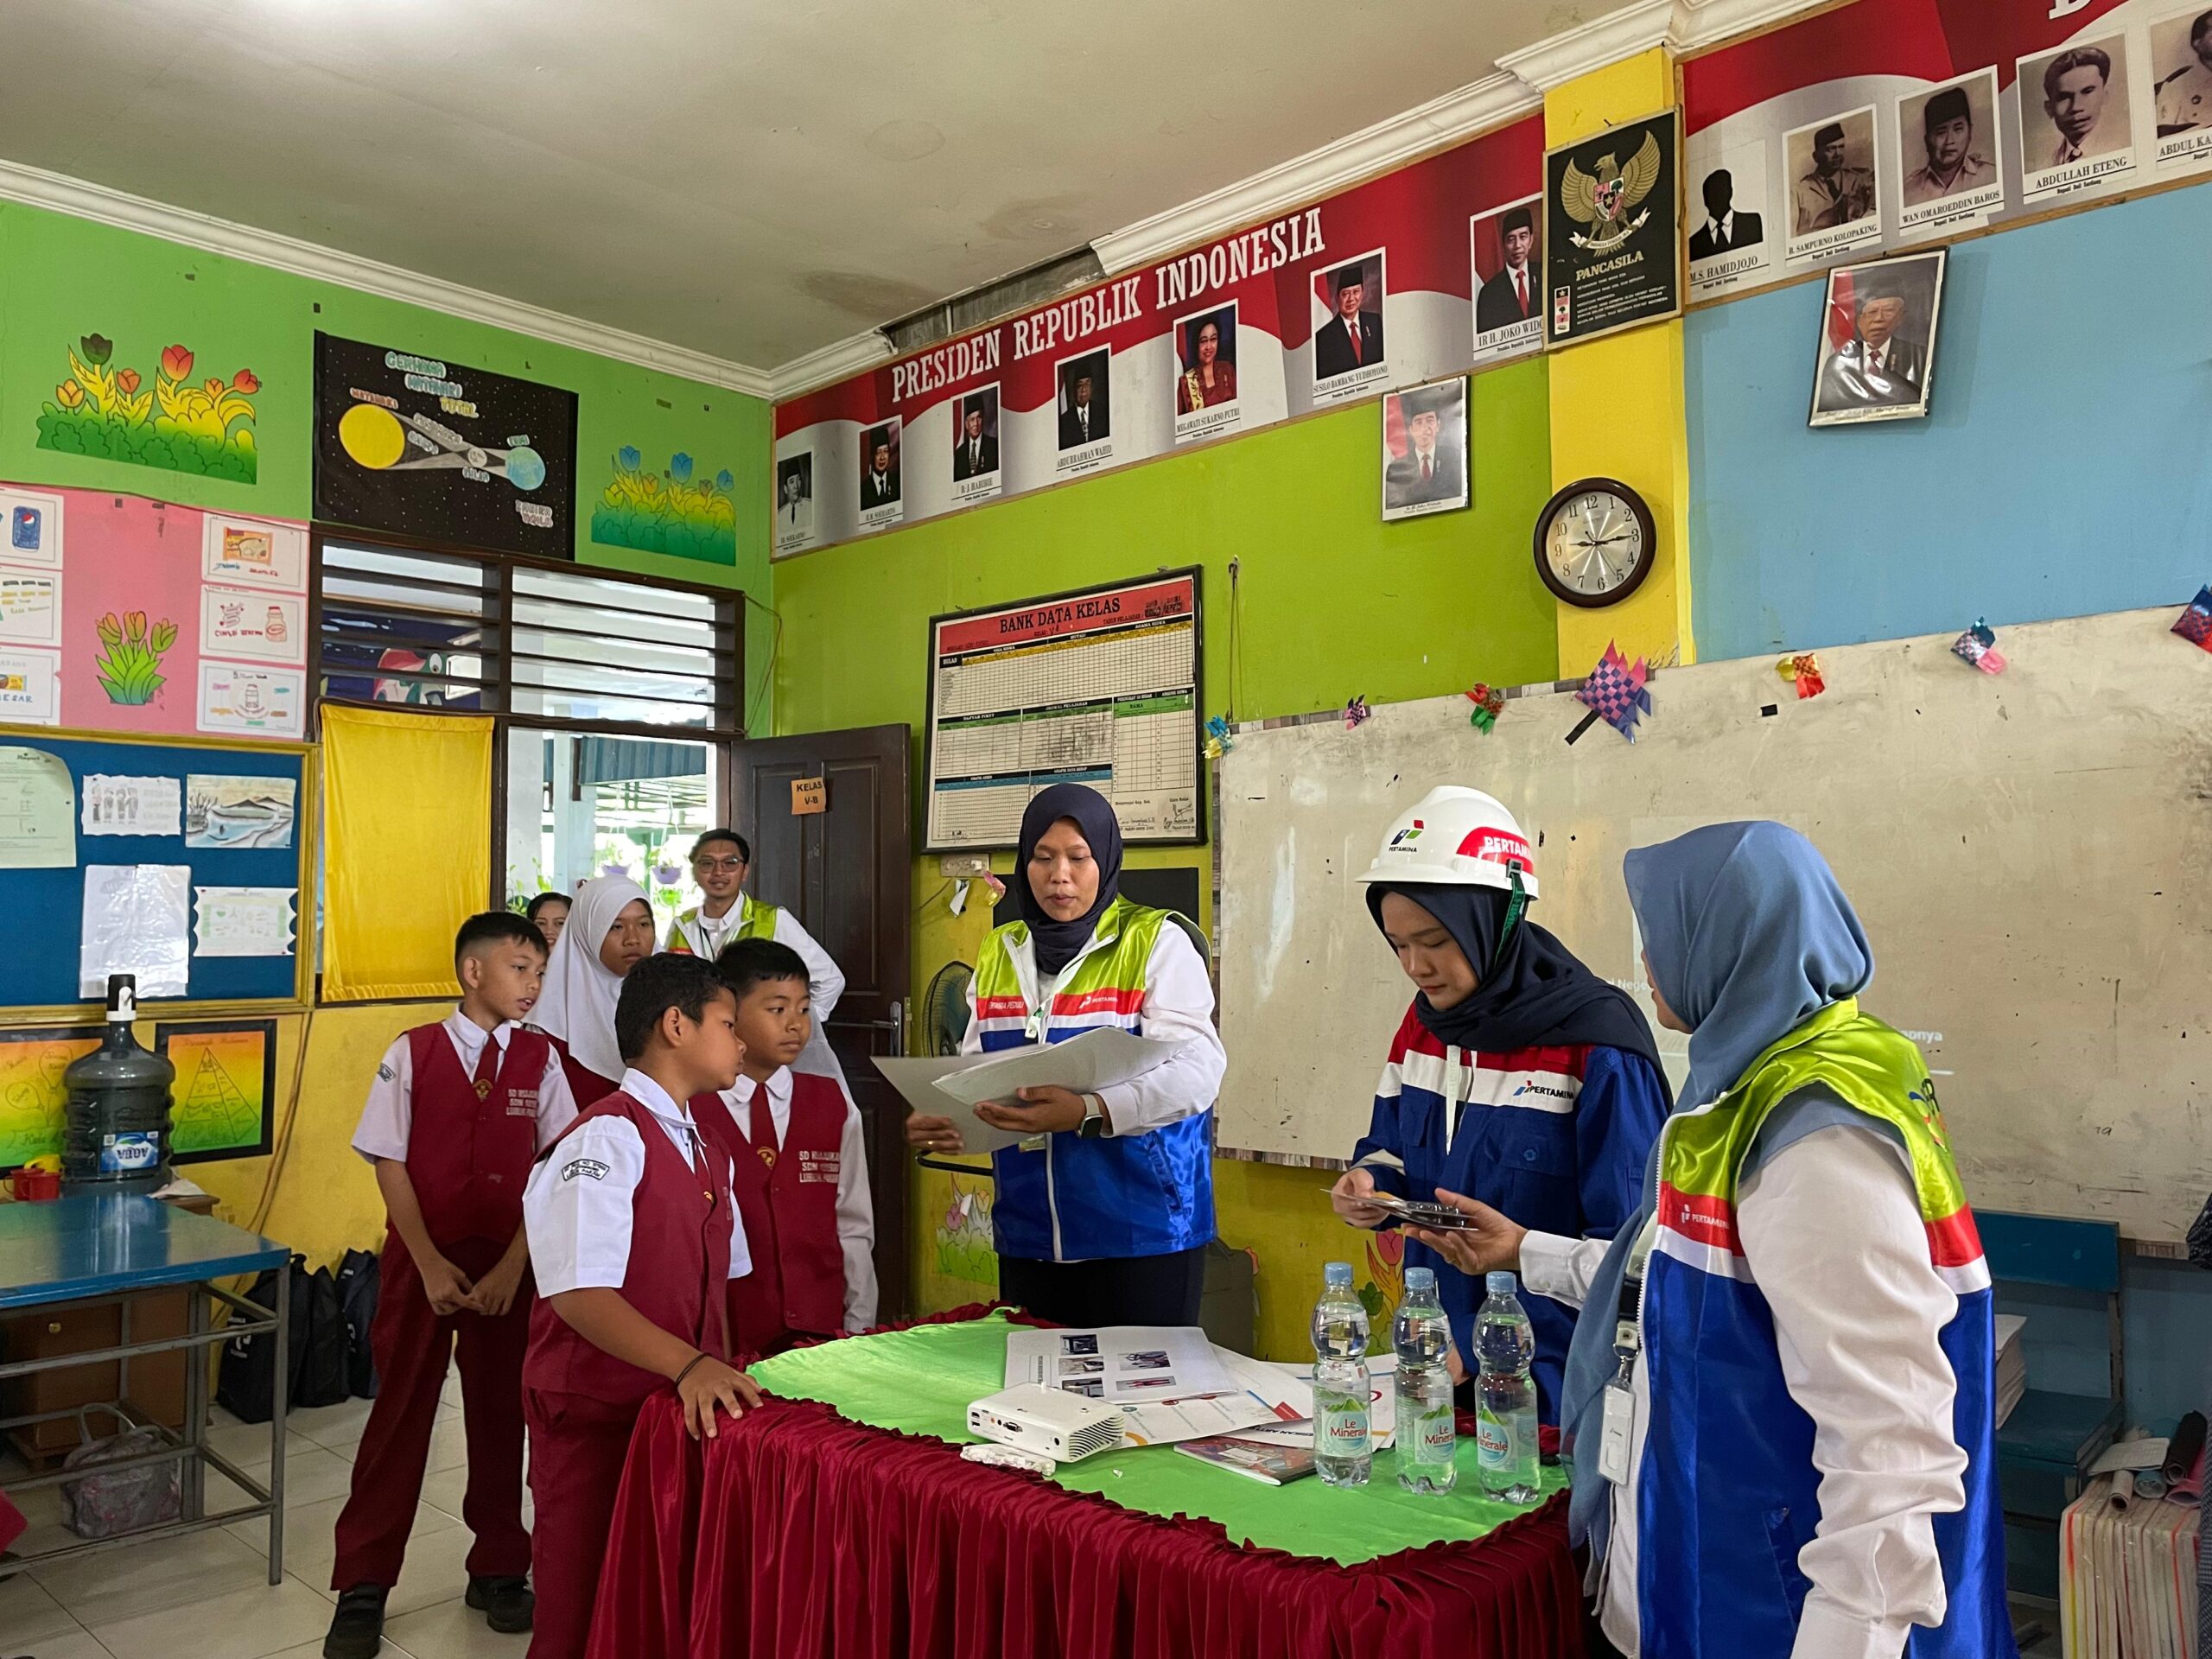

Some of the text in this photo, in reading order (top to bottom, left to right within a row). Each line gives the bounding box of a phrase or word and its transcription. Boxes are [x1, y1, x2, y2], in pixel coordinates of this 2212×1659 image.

[2159, 140, 2195, 158] ABDUL
[2036, 156, 2127, 189] ABDULLAH ETENG
[1903, 190, 2000, 225] WAN OMAROEDDIN BAROS
[1796, 236, 1833, 253] SAMPURNO
[1834, 224, 1878, 244] KOLOPAKING
[1575, 251, 1644, 281] PANCASILA
[1707, 256, 1758, 278] HAMIDJOJO
[891, 207, 1325, 403] PRESIDEN REPUBLIK INDONESIA
[1490, 332, 1498, 345] H.
[1499, 327, 1521, 341] JOKO
[1313, 365, 1387, 393] SUSILO BAMBANG YUDHOYONO
[1177, 408, 1240, 433] MEGAWATI SUKARNO PUTRI
[1057, 450, 1094, 468] ABDURRAHMAN
[1095, 444, 1112, 457] WAHID
[1586, 495, 1598, 510] 12
[1610, 496, 1614, 509] 1
[1568, 504, 1579, 518] 11
[1624, 508, 1632, 522] 2
[1556, 522, 1567, 537] 10
[1631, 529, 1639, 542] 3
[1555, 543, 1562, 556] 9
[1627, 551, 1635, 564] 4
[1563, 563, 1571, 576] 8
[1616, 569, 1624, 582] 5
[1578, 575, 1585, 588] 7
[1598, 577, 1605, 590] 6
[1000, 613, 1034, 633] BANK
[1038, 606, 1072, 627] DATA
[1077, 598, 1121, 620] KELAS
[797, 781, 823, 792] KELAS
[804, 796, 818, 804] V-B
[1484, 836, 1532, 858] PERTAM
[117, 1147, 149, 1160] AQUA
[799, 1150, 809, 1160] SD
[1344, 1418, 1356, 1429] Le
[1439, 1425, 1448, 1435] Le
[1482, 1428, 1491, 1439] Le
[1478, 1437, 1508, 1451] inerale
